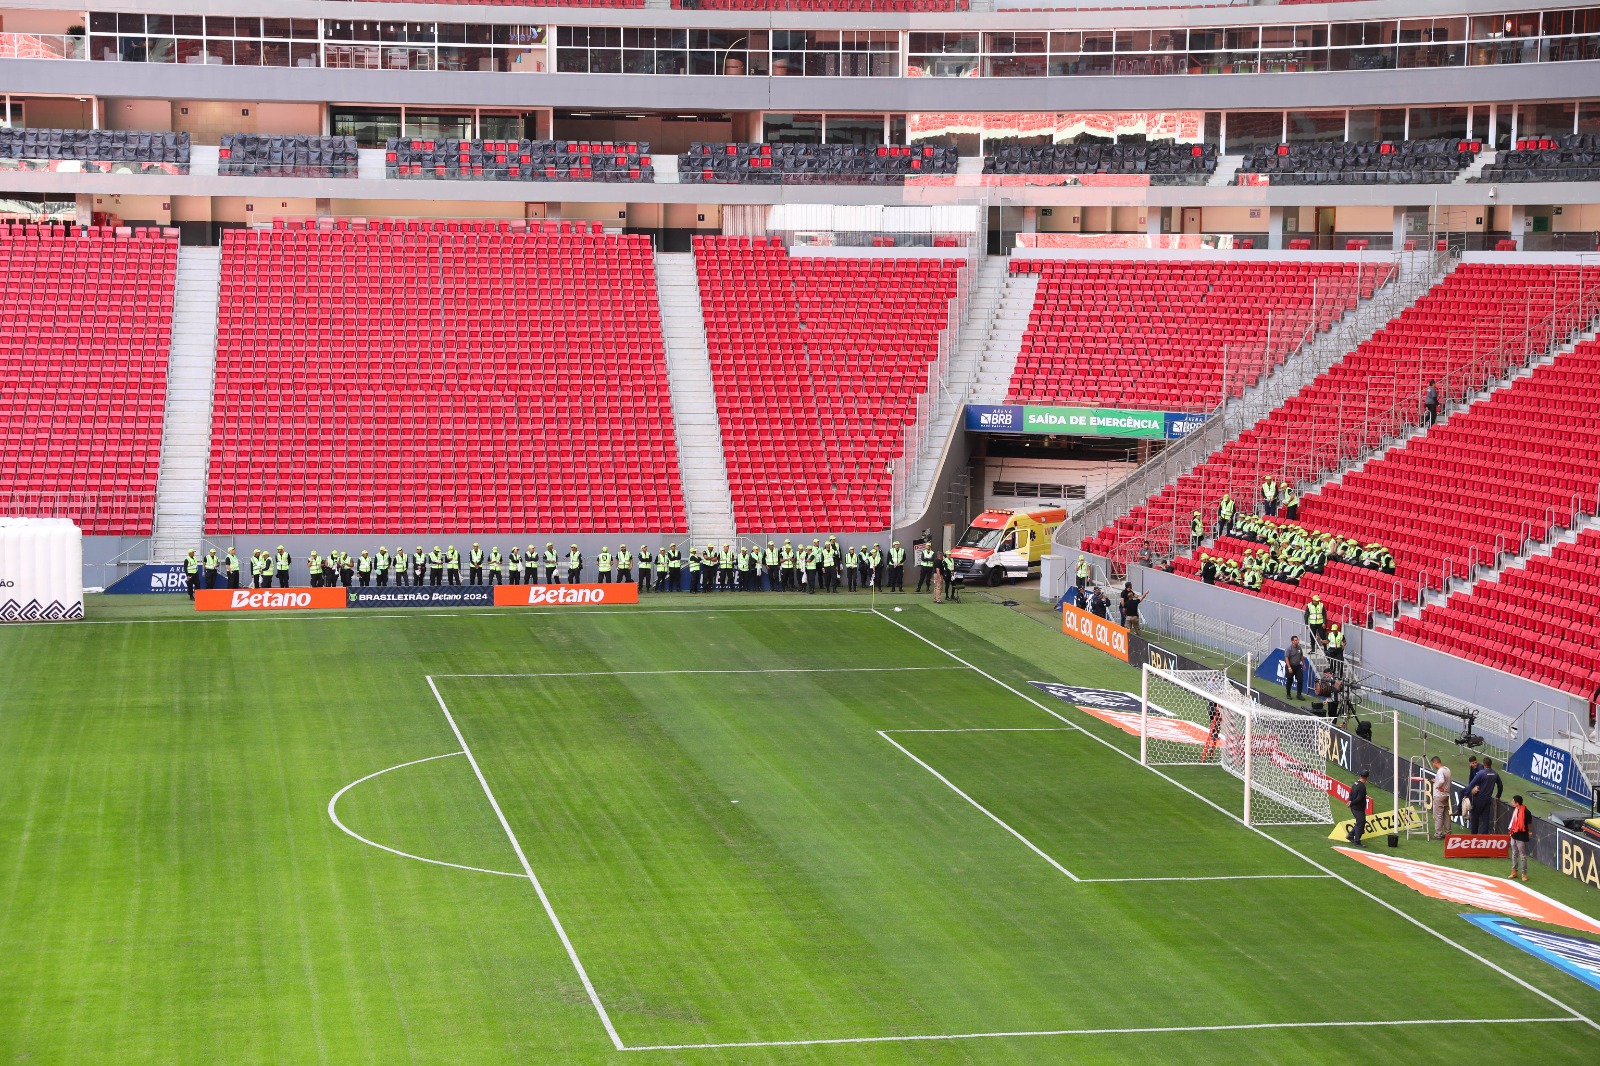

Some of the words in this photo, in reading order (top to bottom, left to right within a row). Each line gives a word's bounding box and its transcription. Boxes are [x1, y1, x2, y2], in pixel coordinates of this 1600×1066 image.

[991, 414, 1012, 425] BRB
[1028, 413, 1067, 425] SAÍDA
[1069, 415, 1087, 426] DE
[1089, 416, 1160, 430] EMERGÊNCIA
[231, 590, 311, 608] Betano
[359, 592, 429, 601] BRASILEIRÃO
[431, 593, 461, 601] Betano
[528, 586, 605, 604] Betano
[1065, 610, 1078, 632] GOL
[1080, 616, 1094, 639] GOL
[1095, 623, 1110, 647] GOL
[1111, 630, 1126, 654] GOL
[1318, 726, 1348, 769] BRAX
[1544, 747, 1565, 761] ARENA
[1541, 757, 1564, 783] BRB
[1446, 837, 1508, 850] Betano
